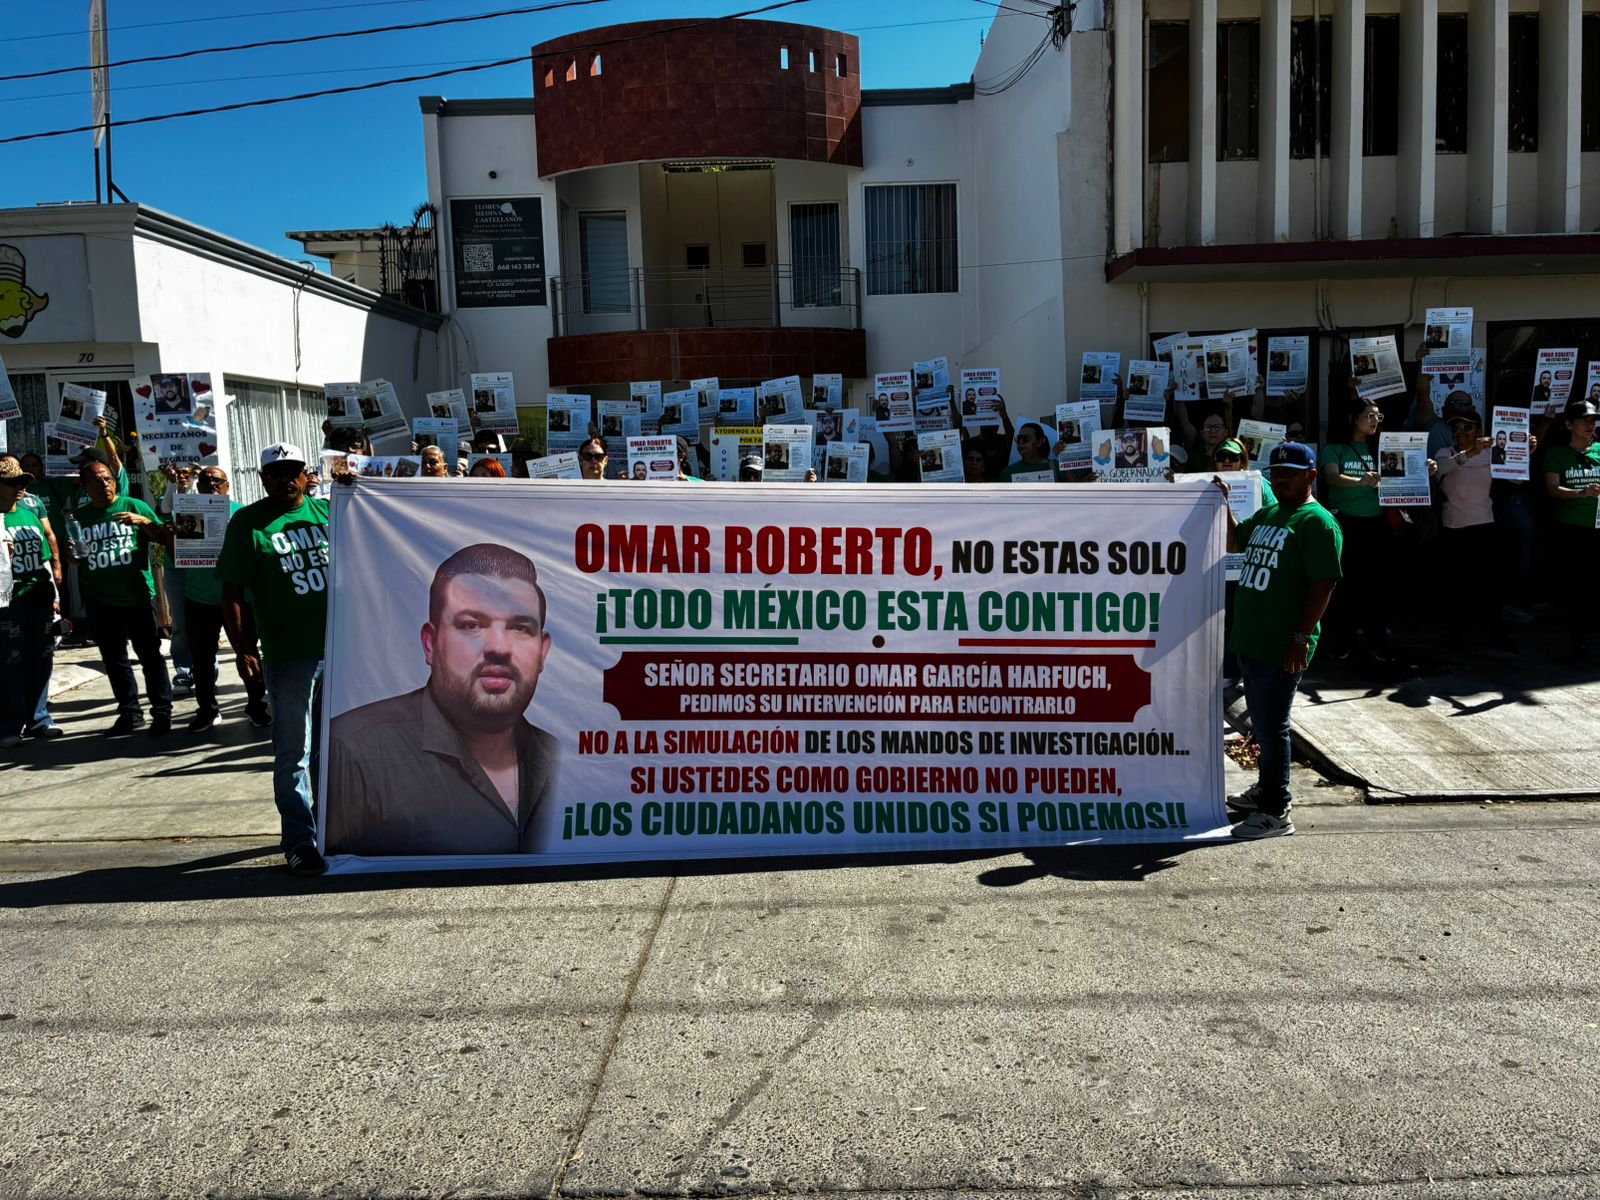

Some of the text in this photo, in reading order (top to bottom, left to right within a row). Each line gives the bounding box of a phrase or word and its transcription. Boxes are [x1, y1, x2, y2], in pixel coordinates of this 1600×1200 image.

[79, 352, 94, 363] 70
[142, 430, 208, 441] NECESITAMOS
[168, 418, 181, 426] TE
[88, 548, 132, 571] SOLO
[279, 553, 305, 574] NO
[575, 523, 1187, 581] OMAR ROBERTO, NO ESTAS SOLO
[1238, 564, 1271, 592] OLO
[595, 583, 1161, 634] ¡TODO MÉXICO ESTA CONTIGO!
[644, 659, 1112, 691] SEÑOR SECRETARIO OMAR GARCÍA HARFUCH,
[679, 691, 1076, 715] PEDIMOS SU INTERVENCIÓN PARA ENCONTRARLO
[578, 725, 1190, 756] NO A LA SIMULACIÓN DE LOS MANDOS DE INVESTIGACIÓN...
[630, 766, 1122, 796] SI USTEDES COMO GOBIERNO NO PUEDEN,
[562, 801, 1190, 840] ¡LOS CIUDADANOS UNIDOS SI PODEMOS!!
